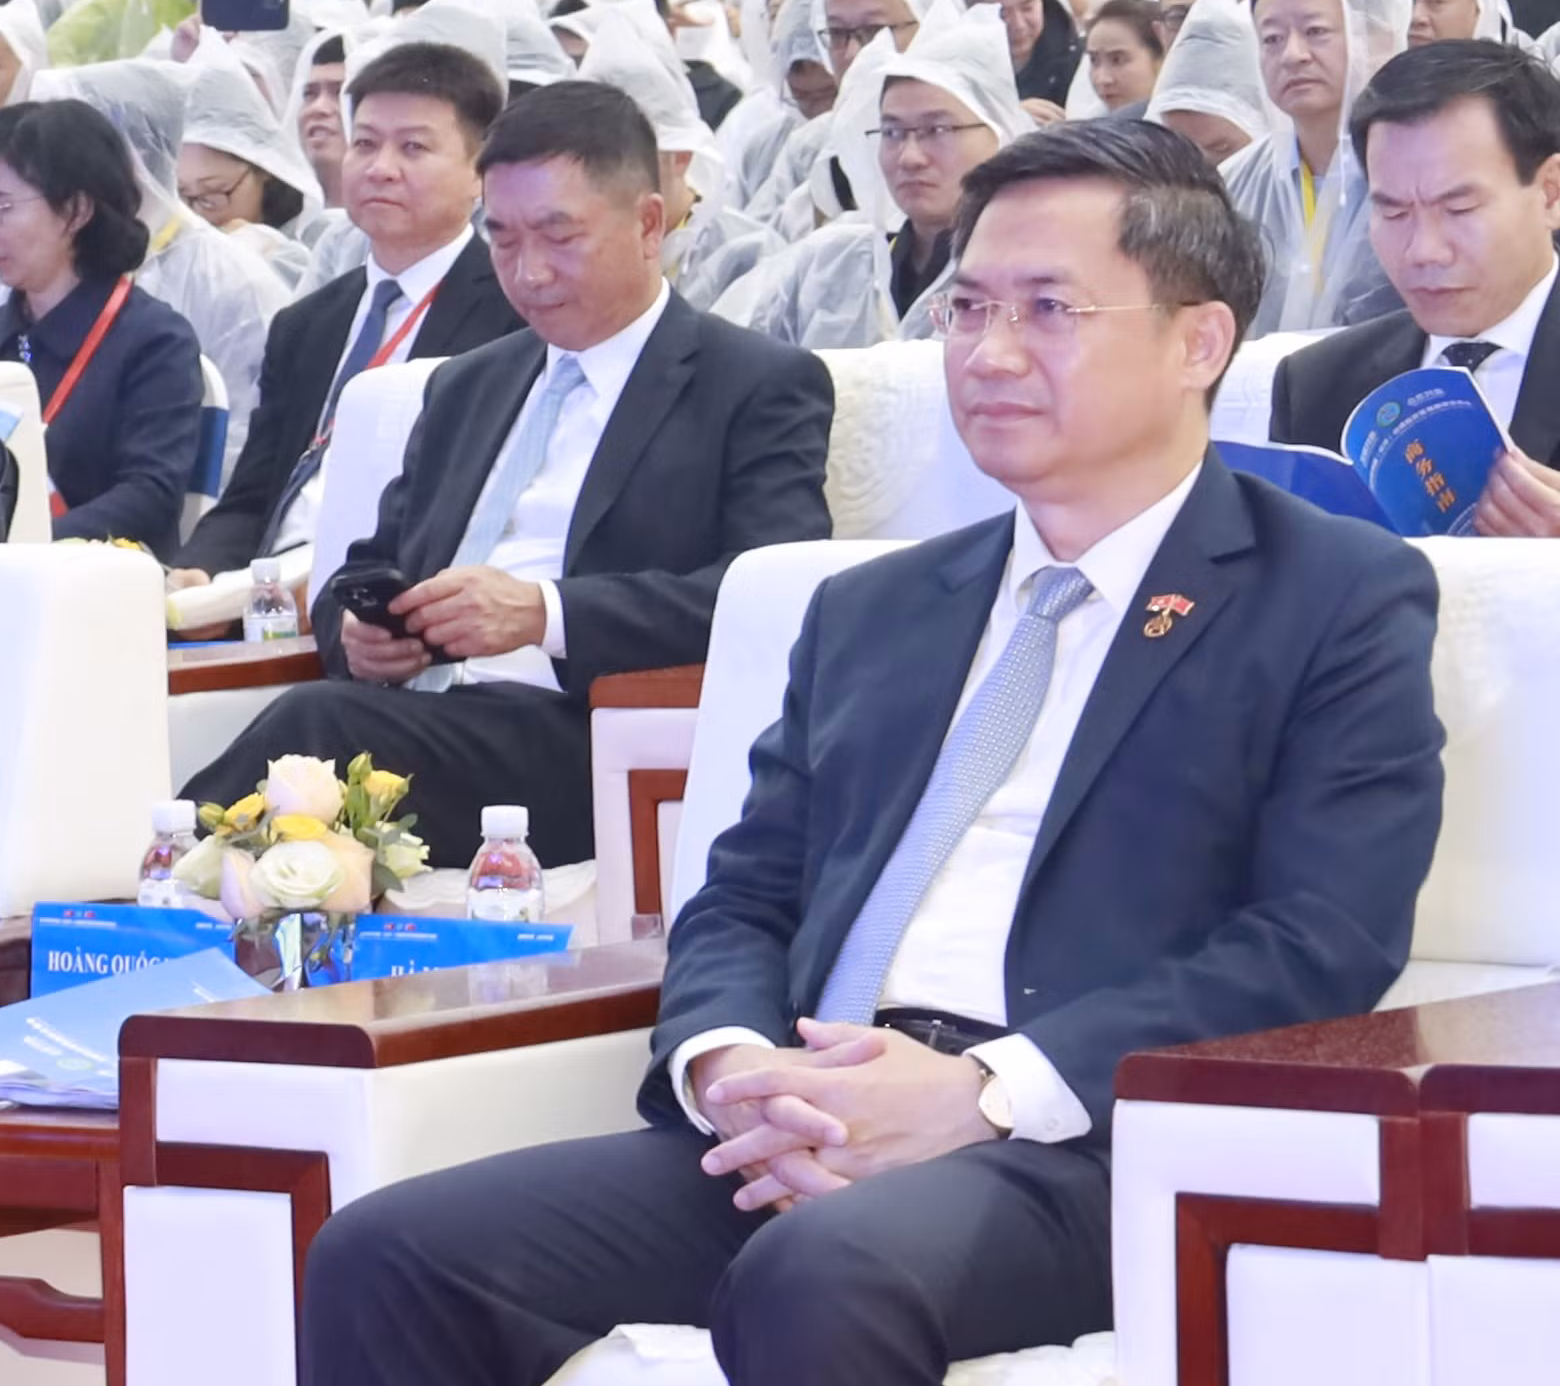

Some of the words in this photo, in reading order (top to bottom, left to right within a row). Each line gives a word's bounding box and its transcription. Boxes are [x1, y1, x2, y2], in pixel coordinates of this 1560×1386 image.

[1405, 438, 1458, 514] 商务指南
[48, 946, 108, 973] HOÀNG
